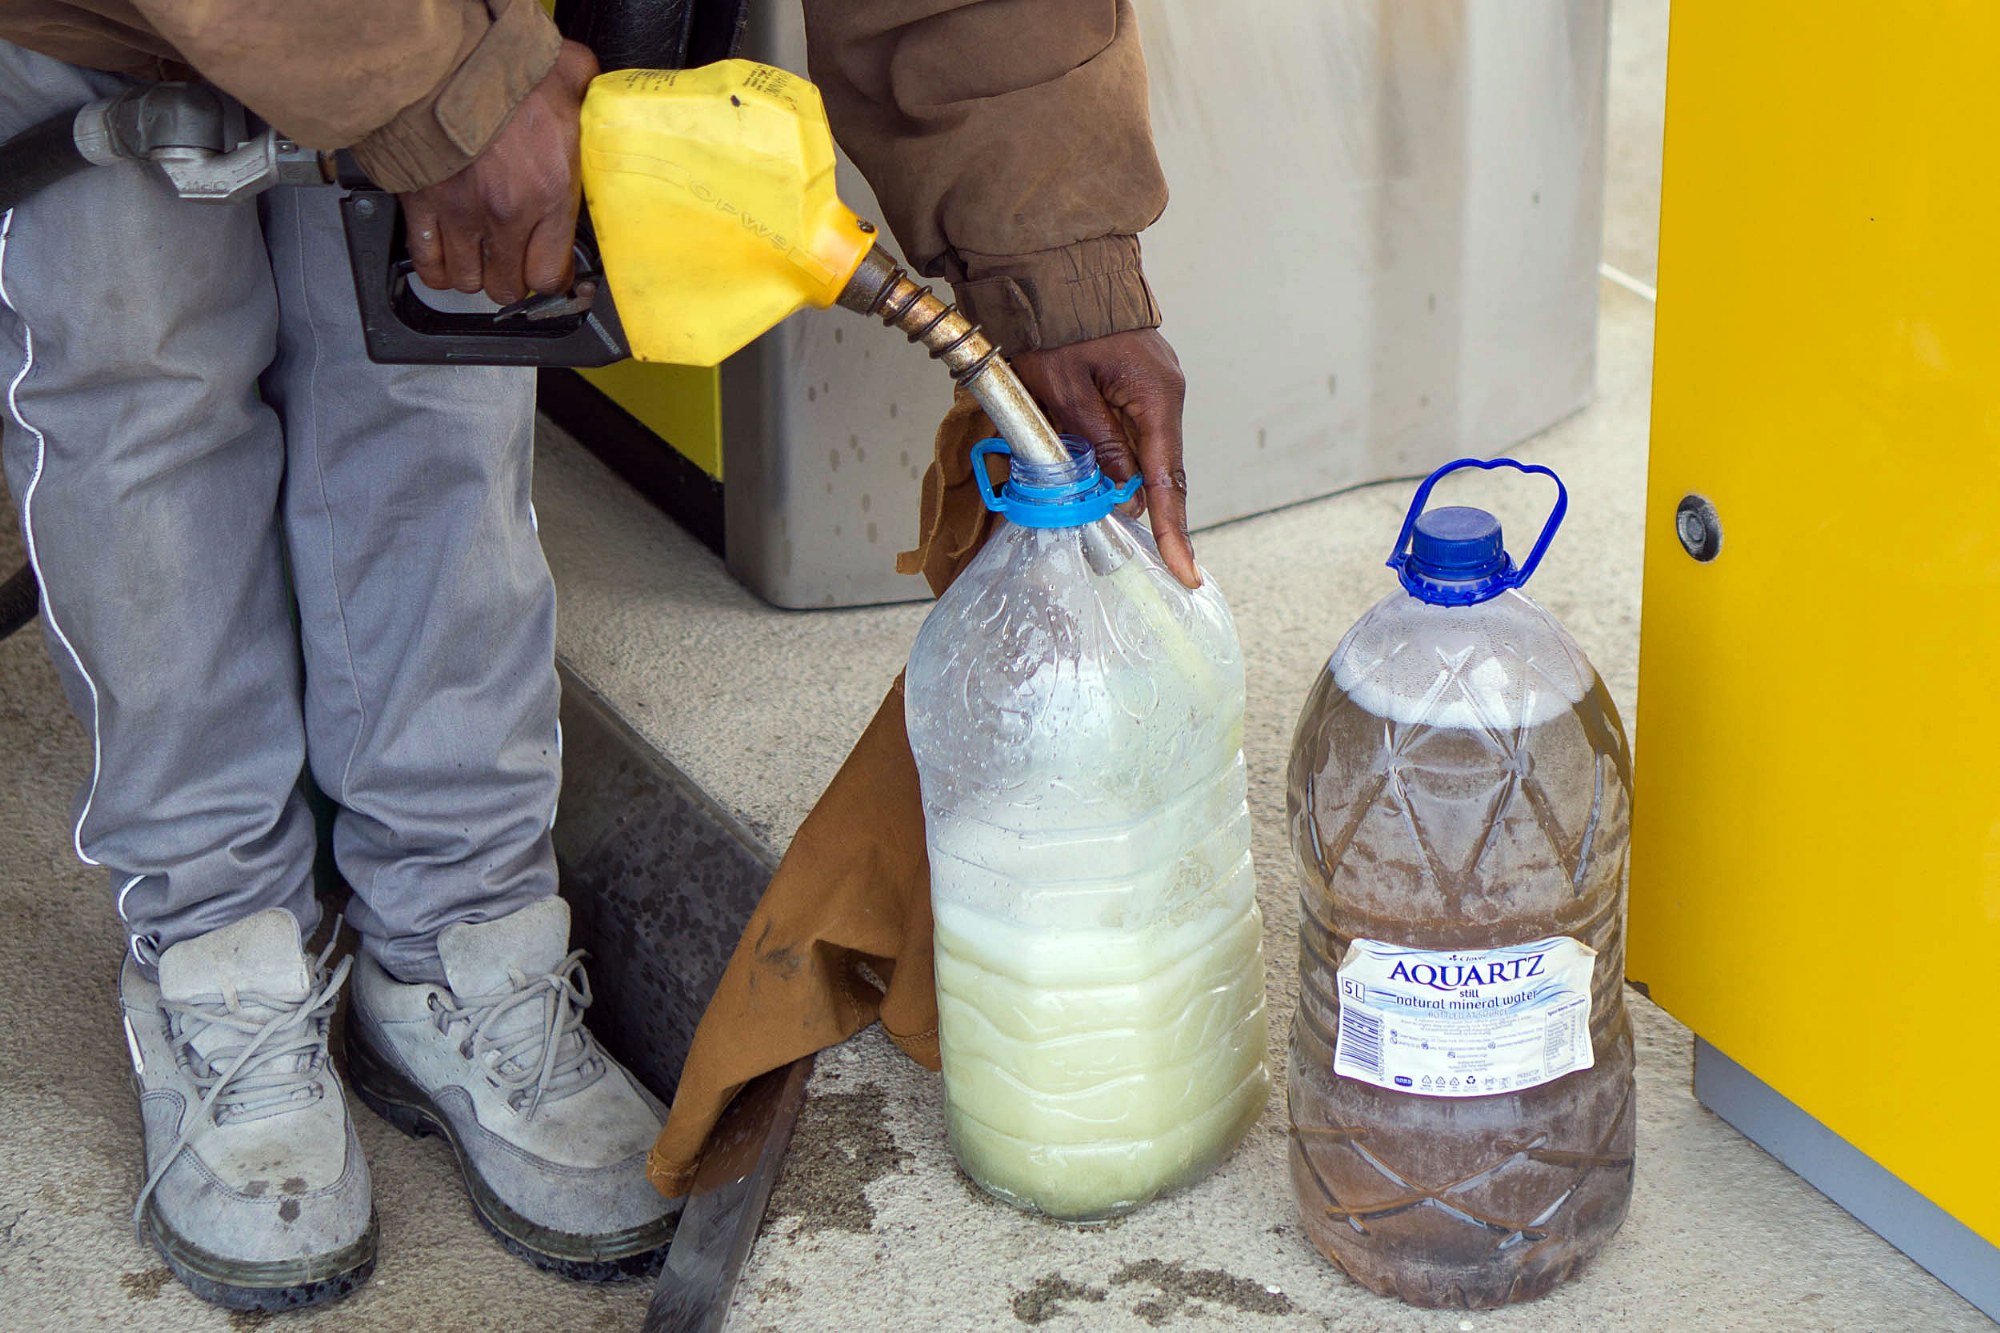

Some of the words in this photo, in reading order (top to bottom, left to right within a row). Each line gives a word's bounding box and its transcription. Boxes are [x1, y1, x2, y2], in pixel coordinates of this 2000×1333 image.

[1387, 954, 1545, 991] AQUARTZ
[1396, 995, 1445, 1010] natural
[1449, 996, 1499, 1011] mineral
[1502, 990, 1538, 1006] water
[1459, 989, 1479, 998] still
